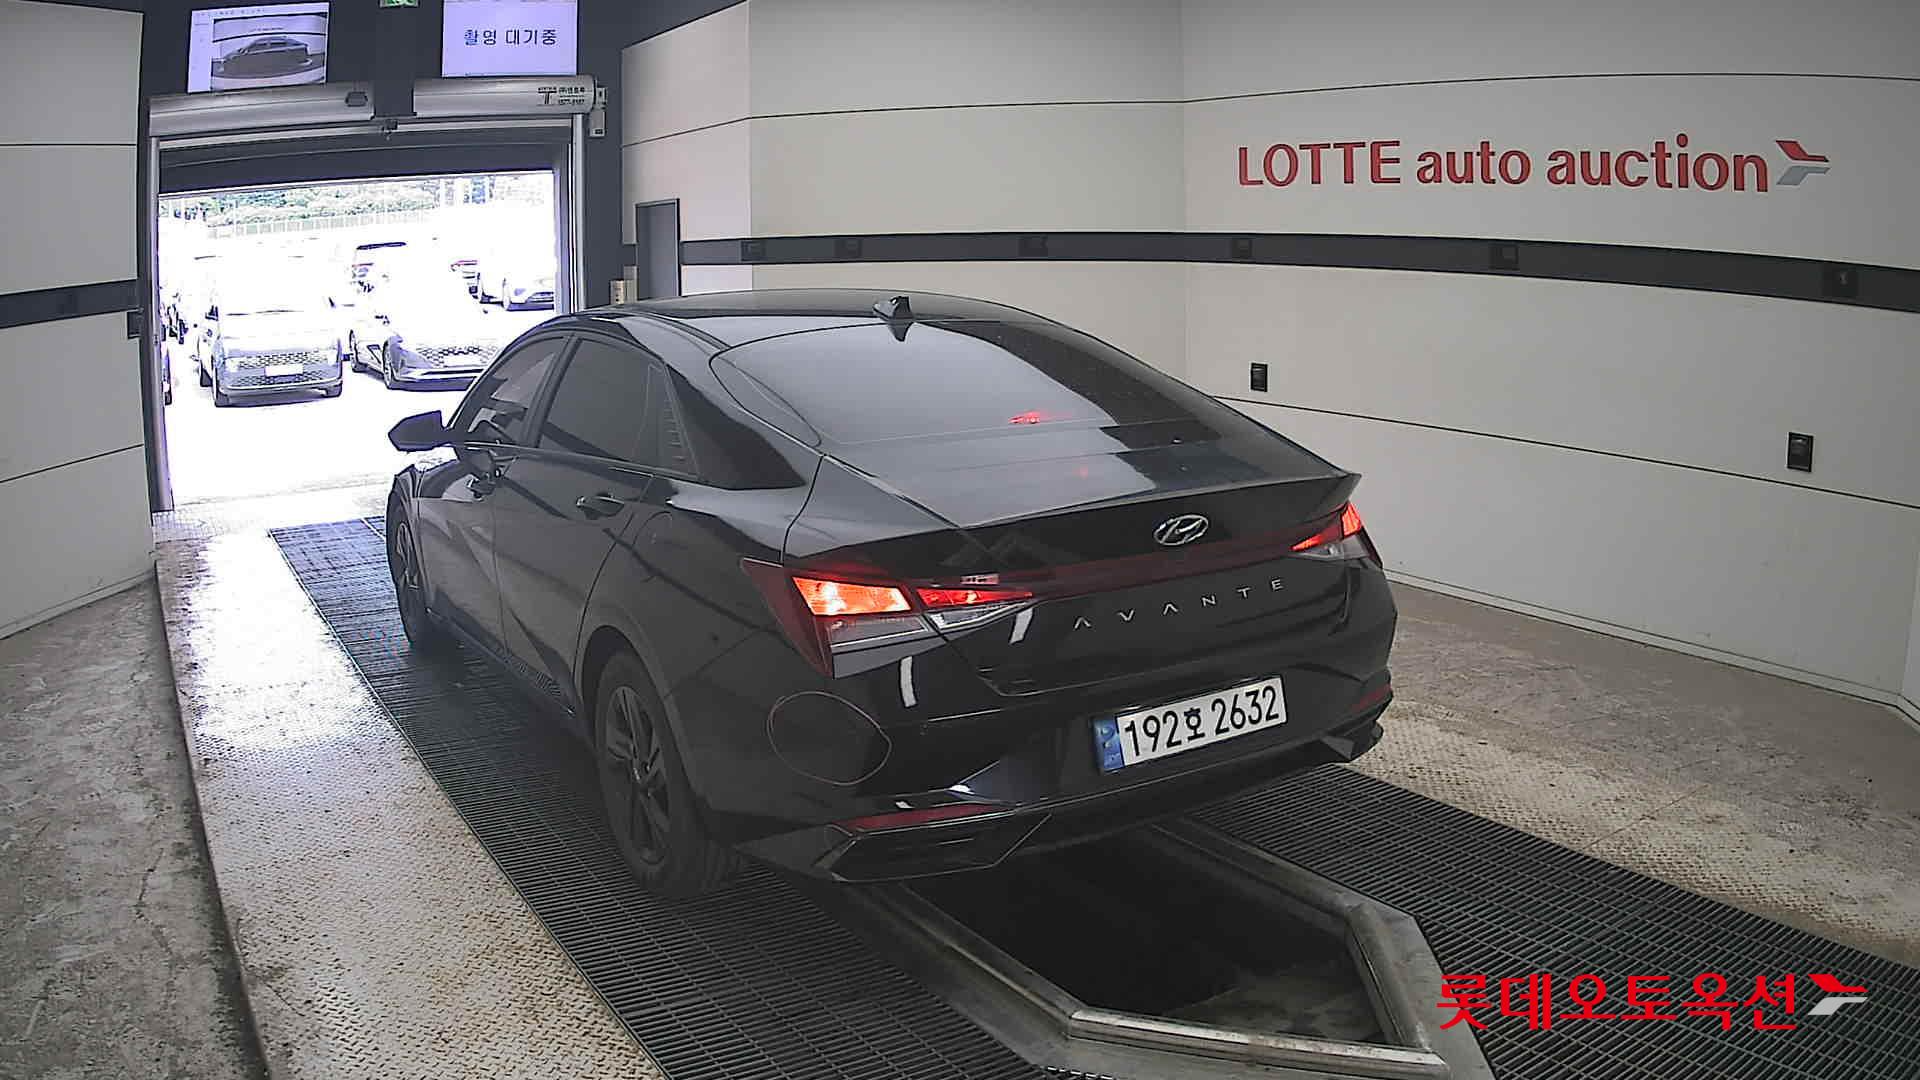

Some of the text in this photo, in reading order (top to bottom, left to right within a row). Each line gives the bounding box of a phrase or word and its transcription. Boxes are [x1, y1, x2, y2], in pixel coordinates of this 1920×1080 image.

[465, 29, 557, 46] 촬영 대기중
[1238, 133, 1769, 192] LOTTE auto auction
[1073, 578, 1284, 630] AVANTE
[1124, 685, 1280, 758] 192호 2632
